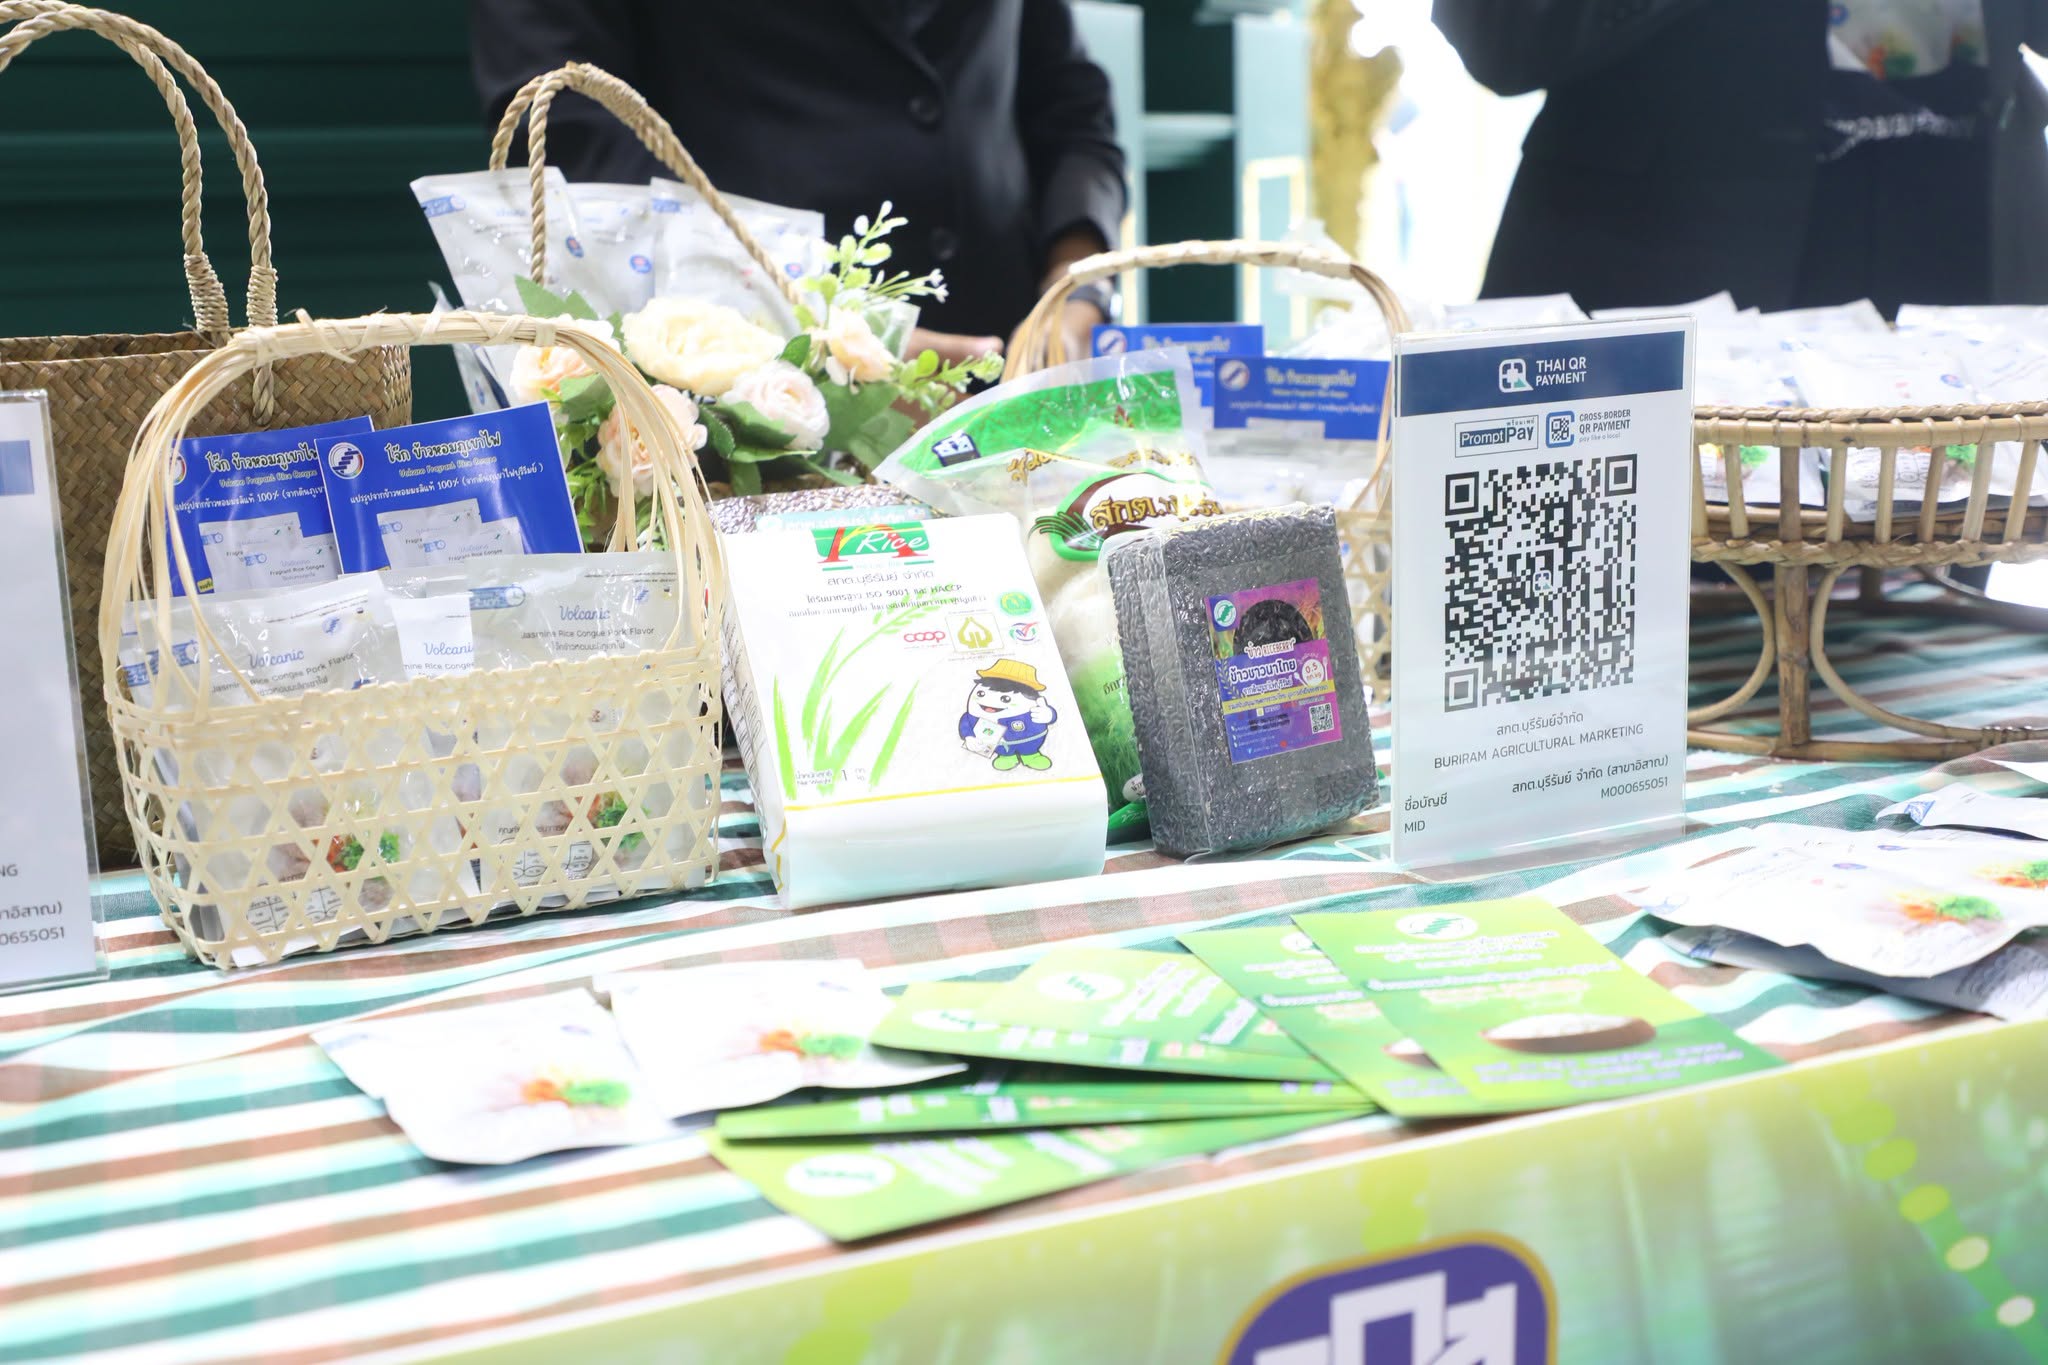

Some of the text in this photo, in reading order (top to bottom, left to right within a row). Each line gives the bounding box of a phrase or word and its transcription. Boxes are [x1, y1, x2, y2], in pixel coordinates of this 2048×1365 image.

[1536, 357, 1587, 373] THAI QR
[1536, 371, 1587, 387] PAYMENT
[1579, 409, 1631, 422] CROSS-BORDER
[1579, 420, 1630, 433] QR PAYMENT
[1460, 426, 1534, 446] PromptPay
[384, 429, 501, 463] โจ๊ก ข้าวหอมภูเขาไฟ
[205, 451, 231, 473] โจ๊ก
[437, 478, 459, 491] 100%
[257, 491, 279, 503] 100%
[856, 530, 928, 554] Rice
[904, 569, 934, 581] จำกัด
[886, 588, 909, 597] 9001
[931, 584, 962, 594] HACCP
[560, 605, 610, 620] Volcanic
[630, 627, 655, 635] Flavor
[305, 663, 327, 674] Pork
[328, 652, 356, 666] Flavor
[1230, 659, 1297, 683] ข้าวชาวนาไทย
[1305, 662, 1318, 674] 0.5
[1496, 711, 1584, 736] สกต.บุรีรัมย์จำกัด
[1434, 723, 1644, 769] BURIRAM AGRICULTURAL MARKETING
[1512, 754, 1669, 793] สกต.บุรีรัมย์ จำกัด (สาขาอิสาณ)
[1601, 777, 1668, 799] M000655051
[1404, 792, 1448, 812] ชื่อบัญชี
[1404, 820, 1426, 834] MID
